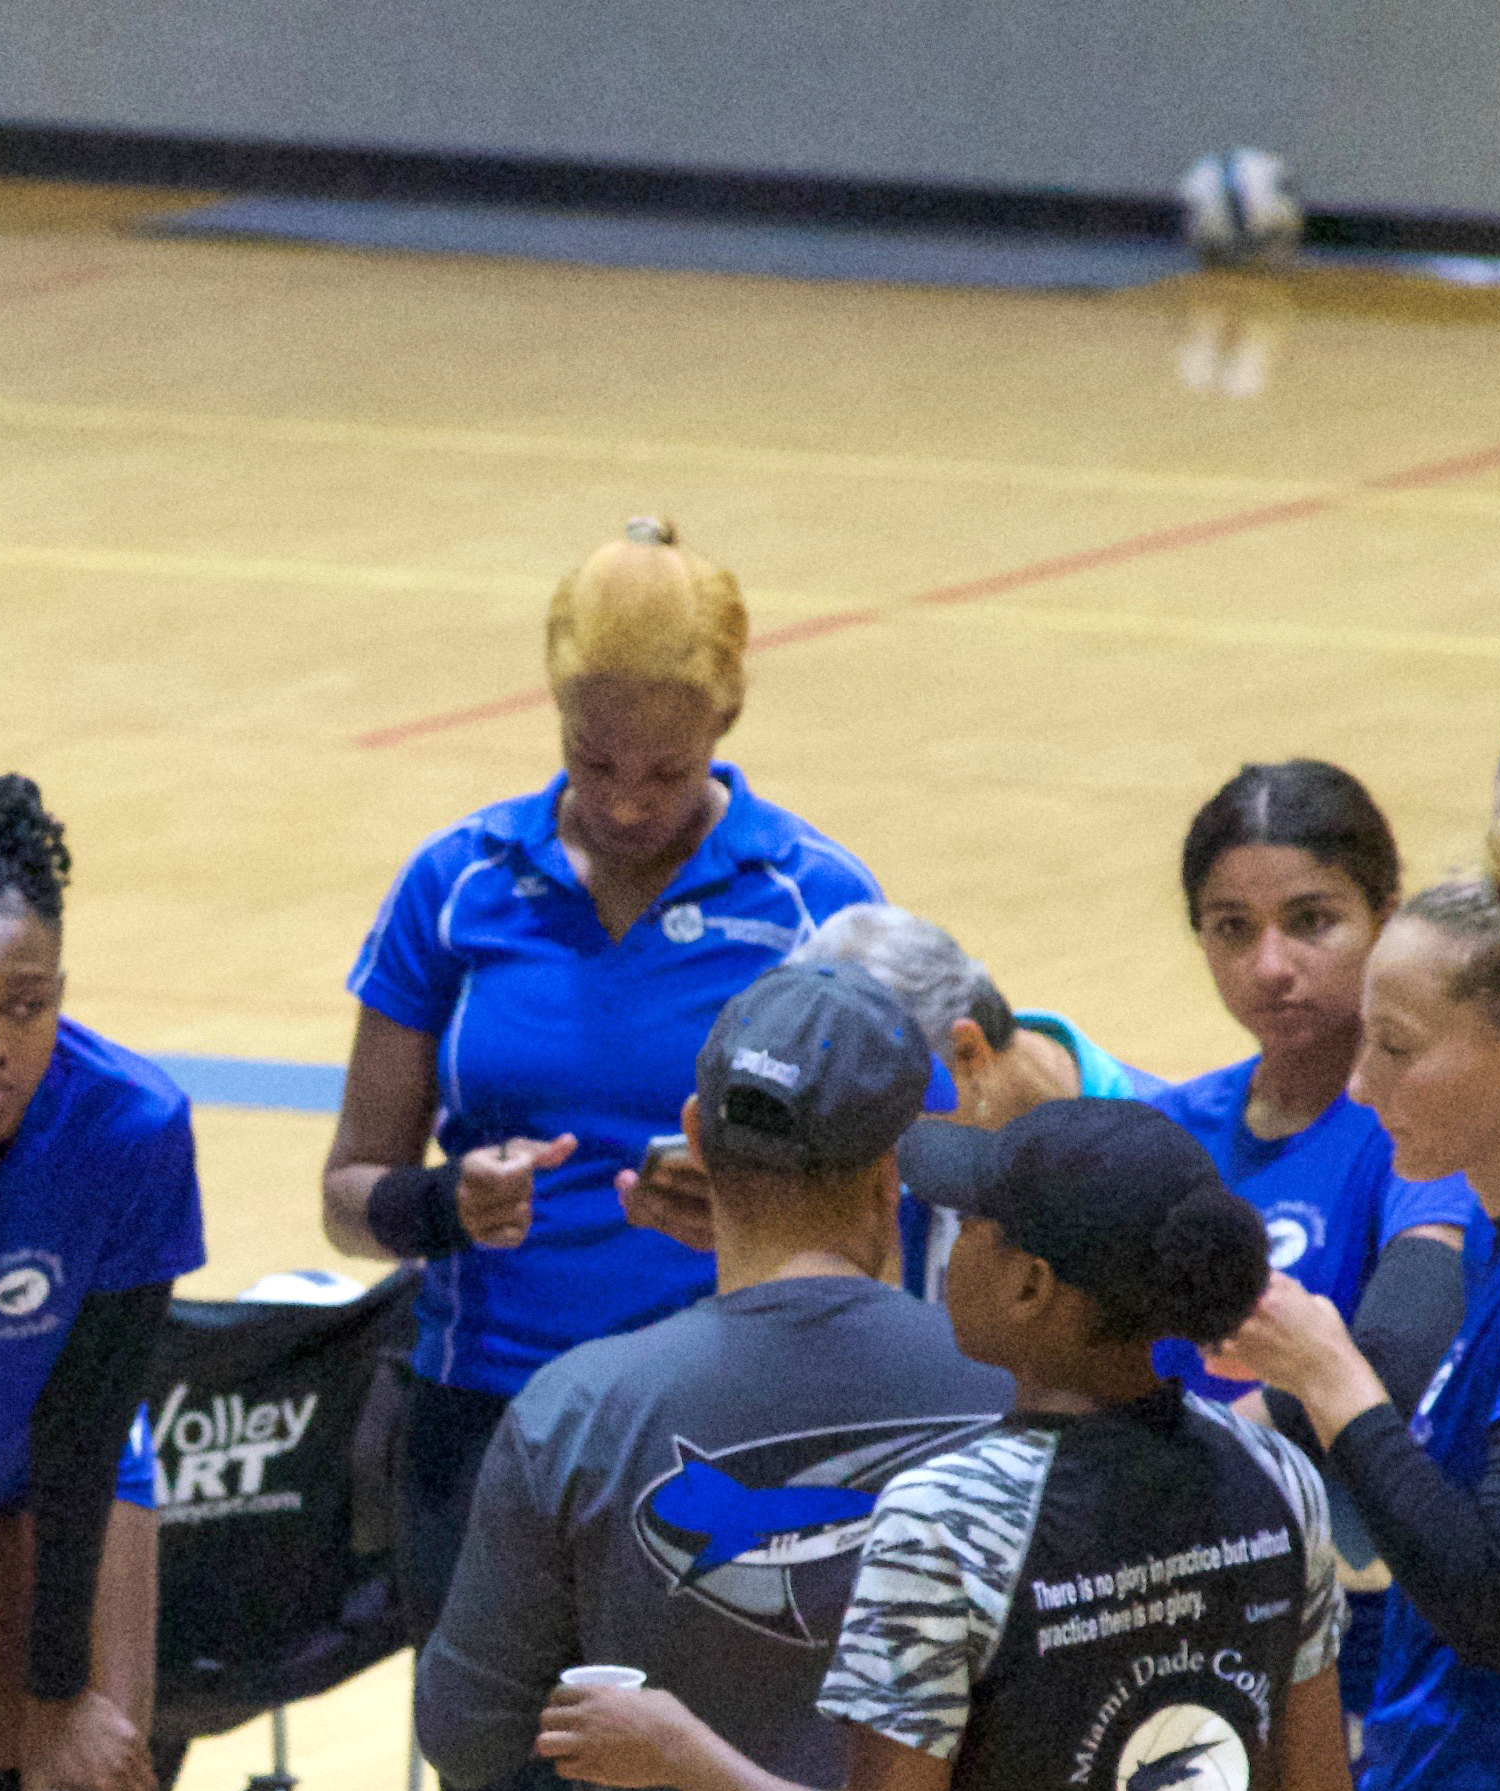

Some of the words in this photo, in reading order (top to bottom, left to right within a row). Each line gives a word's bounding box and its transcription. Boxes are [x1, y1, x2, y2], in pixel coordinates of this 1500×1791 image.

[153, 1441, 278, 1505] RT
[1032, 1578, 1078, 1611] There
[1076, 1573, 1095, 1602] is
[1094, 1572, 1115, 1598] no
[1115, 1561, 1148, 1600] glory
[1164, 1544, 1222, 1586] practice
[1221, 1535, 1249, 1566] but
[1037, 1614, 1098, 1657] practice
[1069, 1678, 1131, 1785] Miami
[1133, 1638, 1205, 1687] Dade
